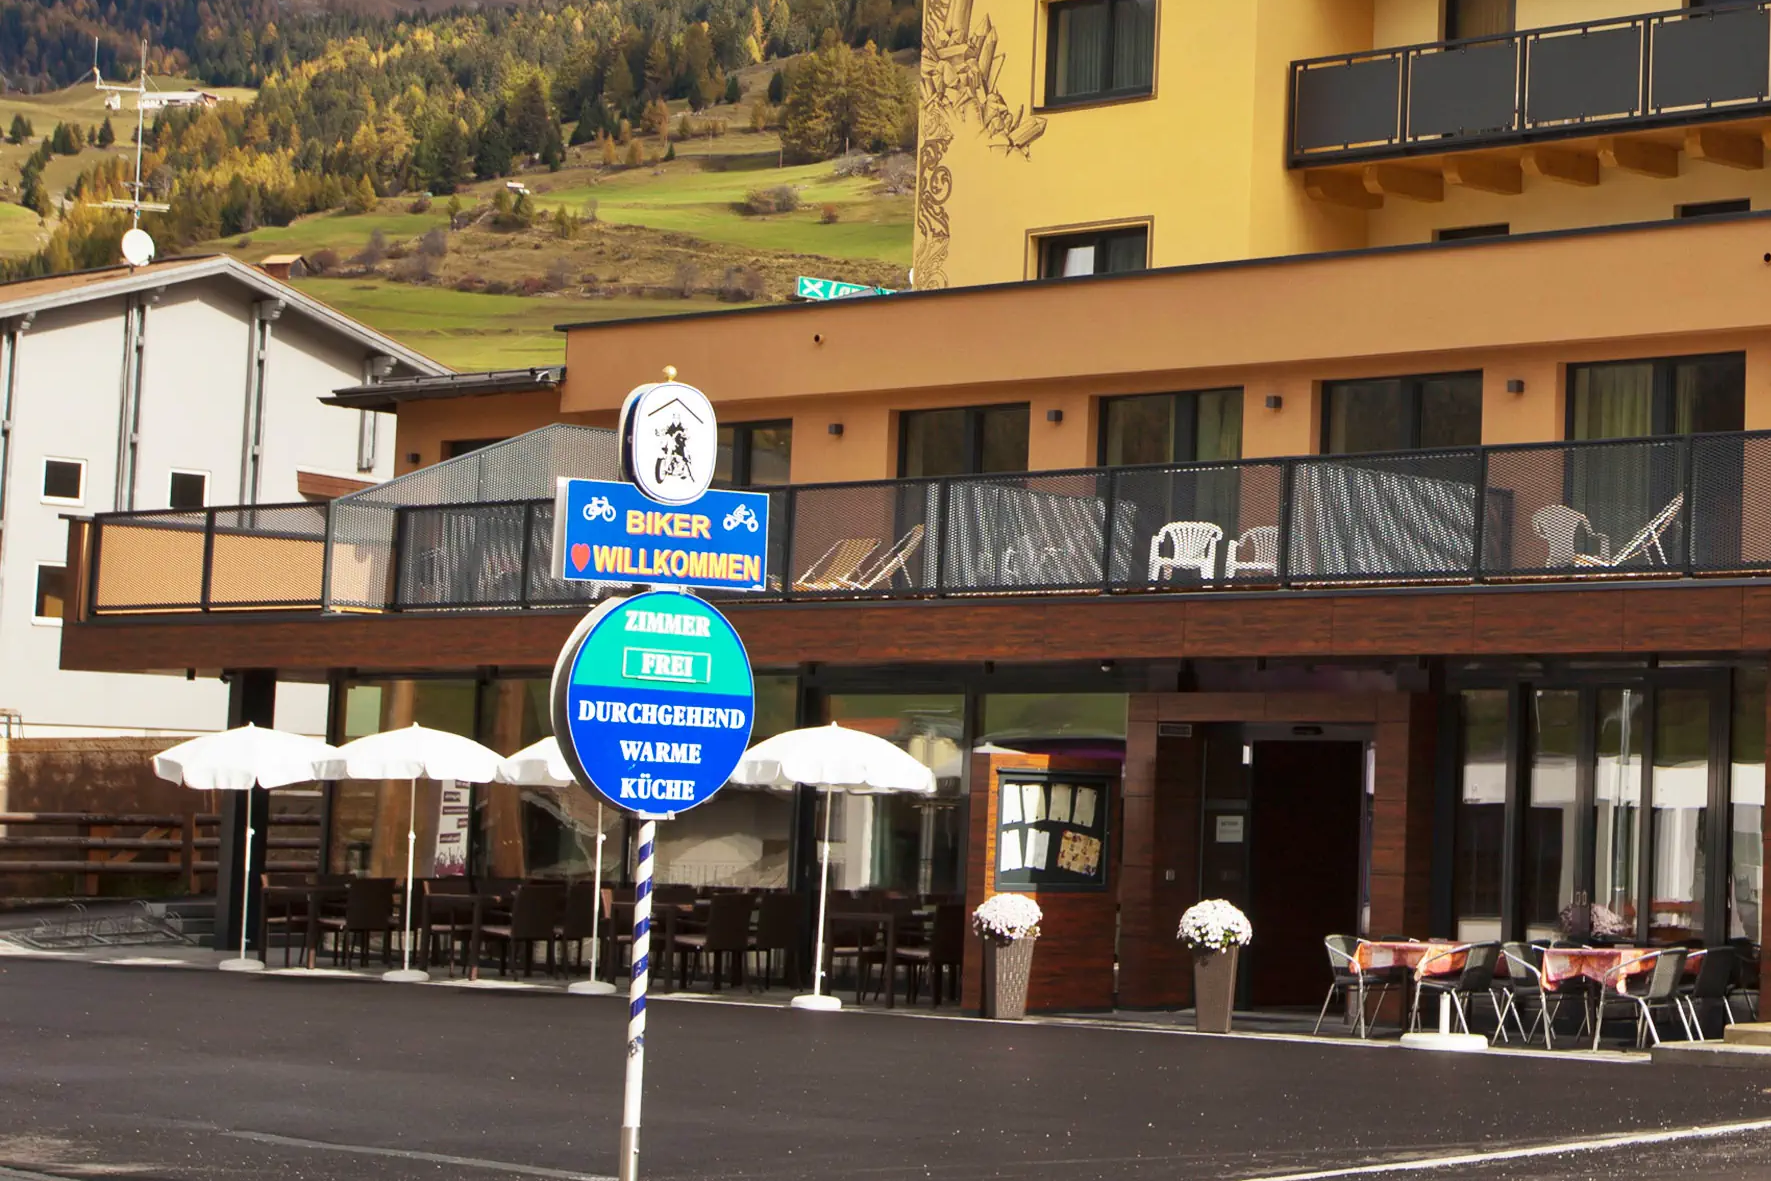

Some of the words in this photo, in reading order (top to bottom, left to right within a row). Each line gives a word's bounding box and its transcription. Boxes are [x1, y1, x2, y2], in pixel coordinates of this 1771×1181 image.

[625, 511, 712, 540] BIKER
[593, 545, 761, 583] WILLKOMMEN
[625, 610, 711, 638] ZIMMER
[641, 652, 694, 677] FREI
[578, 700, 746, 730] DURCHGEHEND
[619, 740, 702, 764] WARME
[619, 773, 696, 802] KÜCHE
